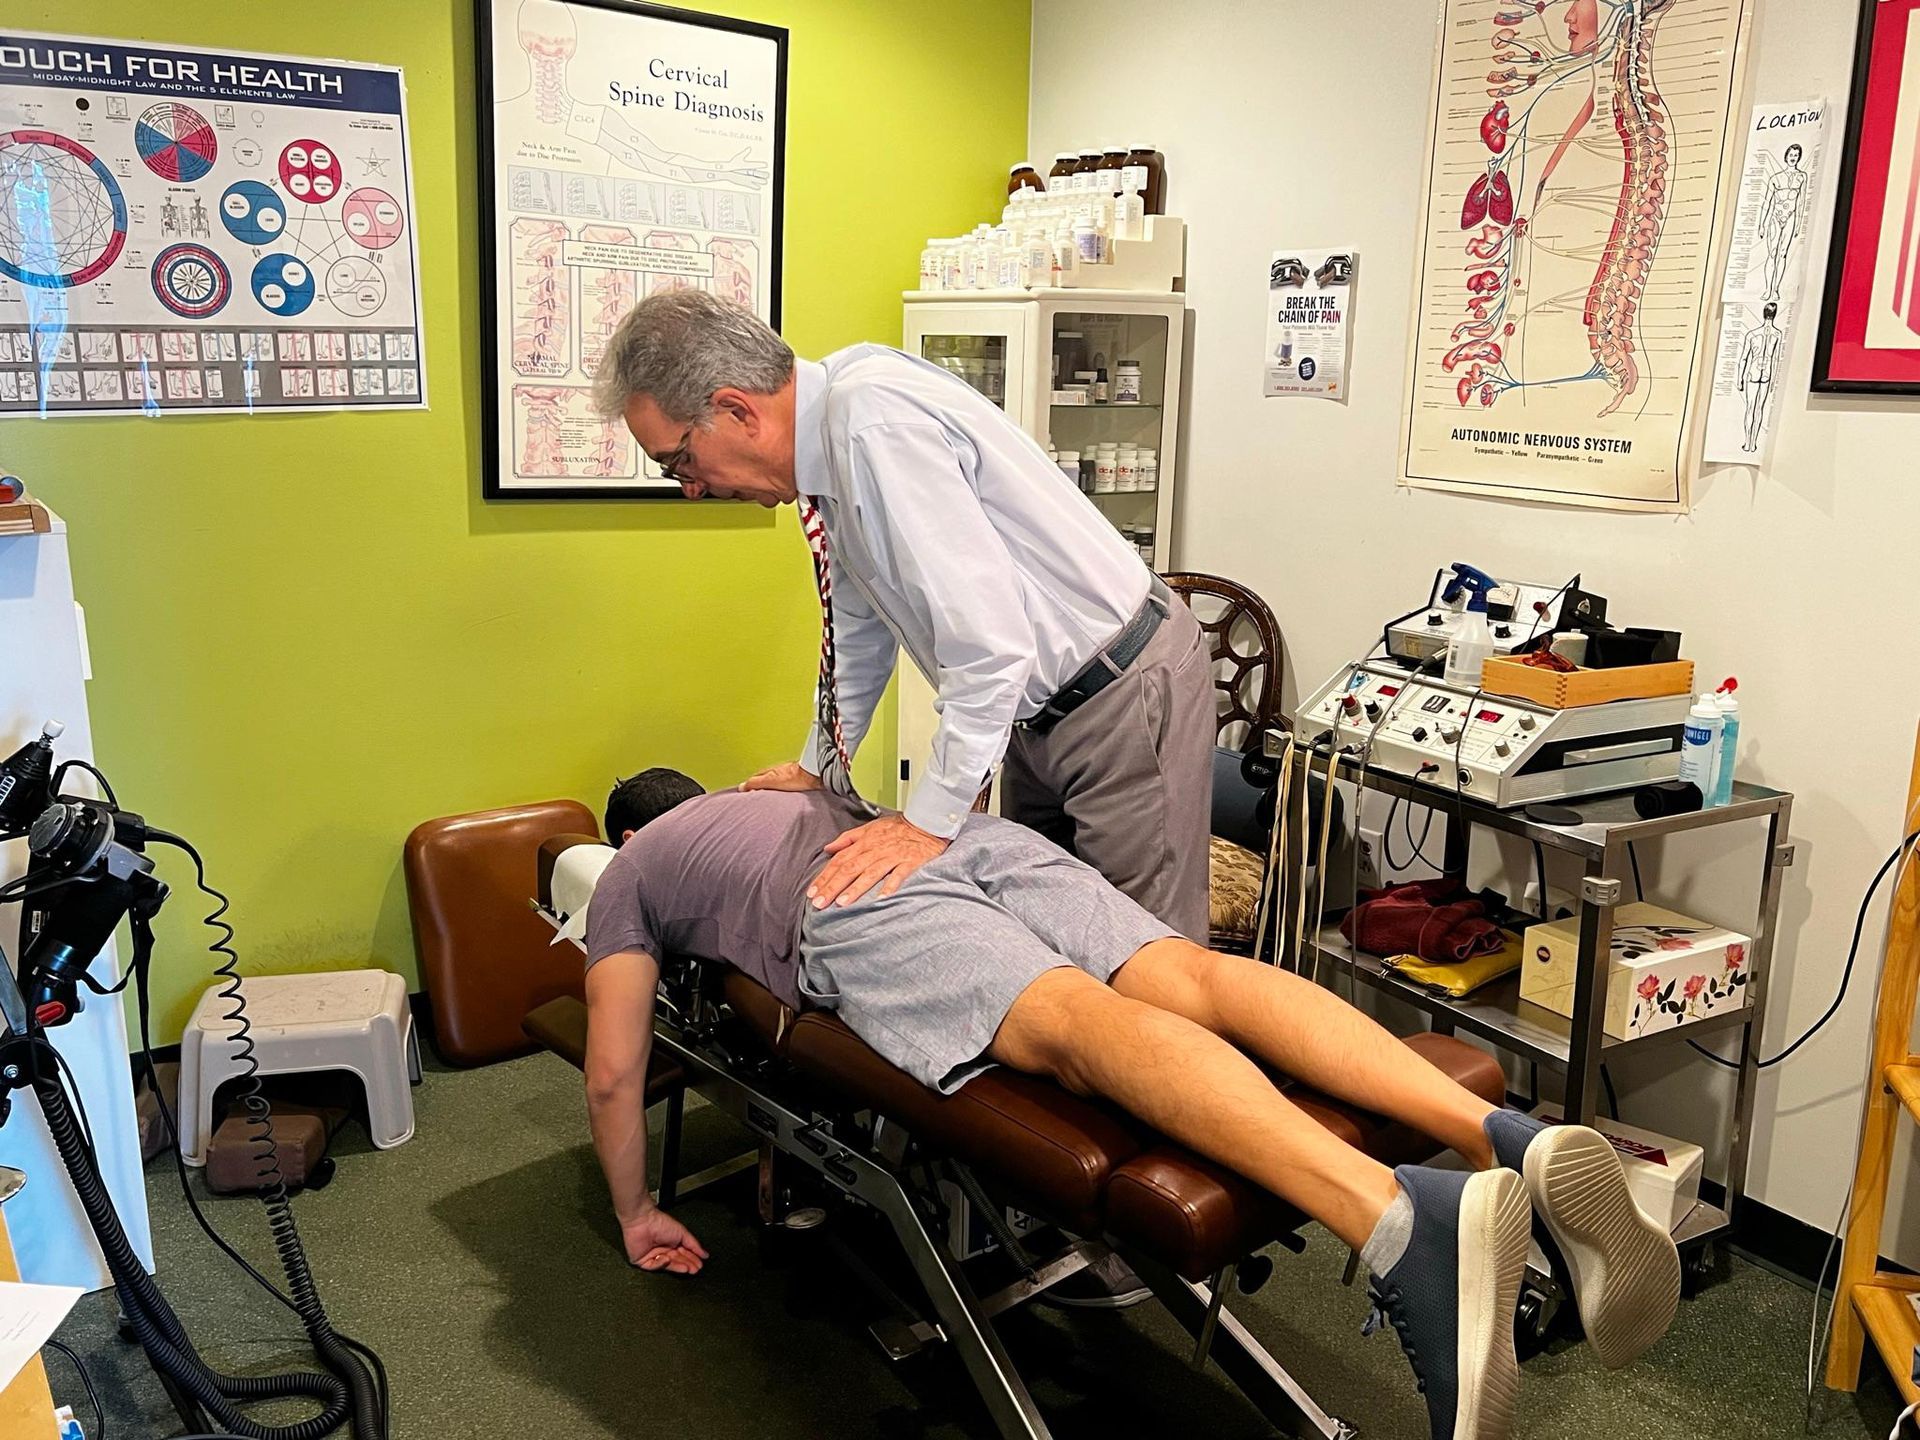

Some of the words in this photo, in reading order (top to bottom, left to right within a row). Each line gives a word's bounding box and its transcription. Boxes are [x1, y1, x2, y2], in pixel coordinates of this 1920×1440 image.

[33, 73, 131, 87] MIDDAY-MIDNIGHT
[135, 80, 157, 88] LAW
[160, 82, 182, 91] AND
[185, 84, 206, 93] THE
[209, 86, 217, 94] 5
[220, 87, 272, 98] ELEMENTS
[276, 92, 296, 100] LAW
[126, 56, 200, 82] FOR
[212, 63, 343, 95] HEALTH
[649, 58, 728, 89] Cervical
[609, 80, 664, 107] Spine
[675, 90, 764, 123] Diagnosis
[1756, 108, 1824, 131] LOCATION
[1286, 296, 1317, 310] BREAK
[1319, 296, 1336, 310] THE
[1278, 310, 1307, 323] CHAIN
[1308, 310, 1320, 323] OF
[1321, 310, 1341, 324] PAIN
[1451, 428, 1520, 445] AUTONOMIC
[1524, 433, 1580, 450] NERVOUS
[1584, 437, 1632, 455] SYSTEM
[1474, 446, 1504, 456] Sympathetic
[1511, 449, 1528, 457] Yellow
[1536, 451, 1580, 462] Parasympathetic
[1587, 455, 1604, 464] Green
